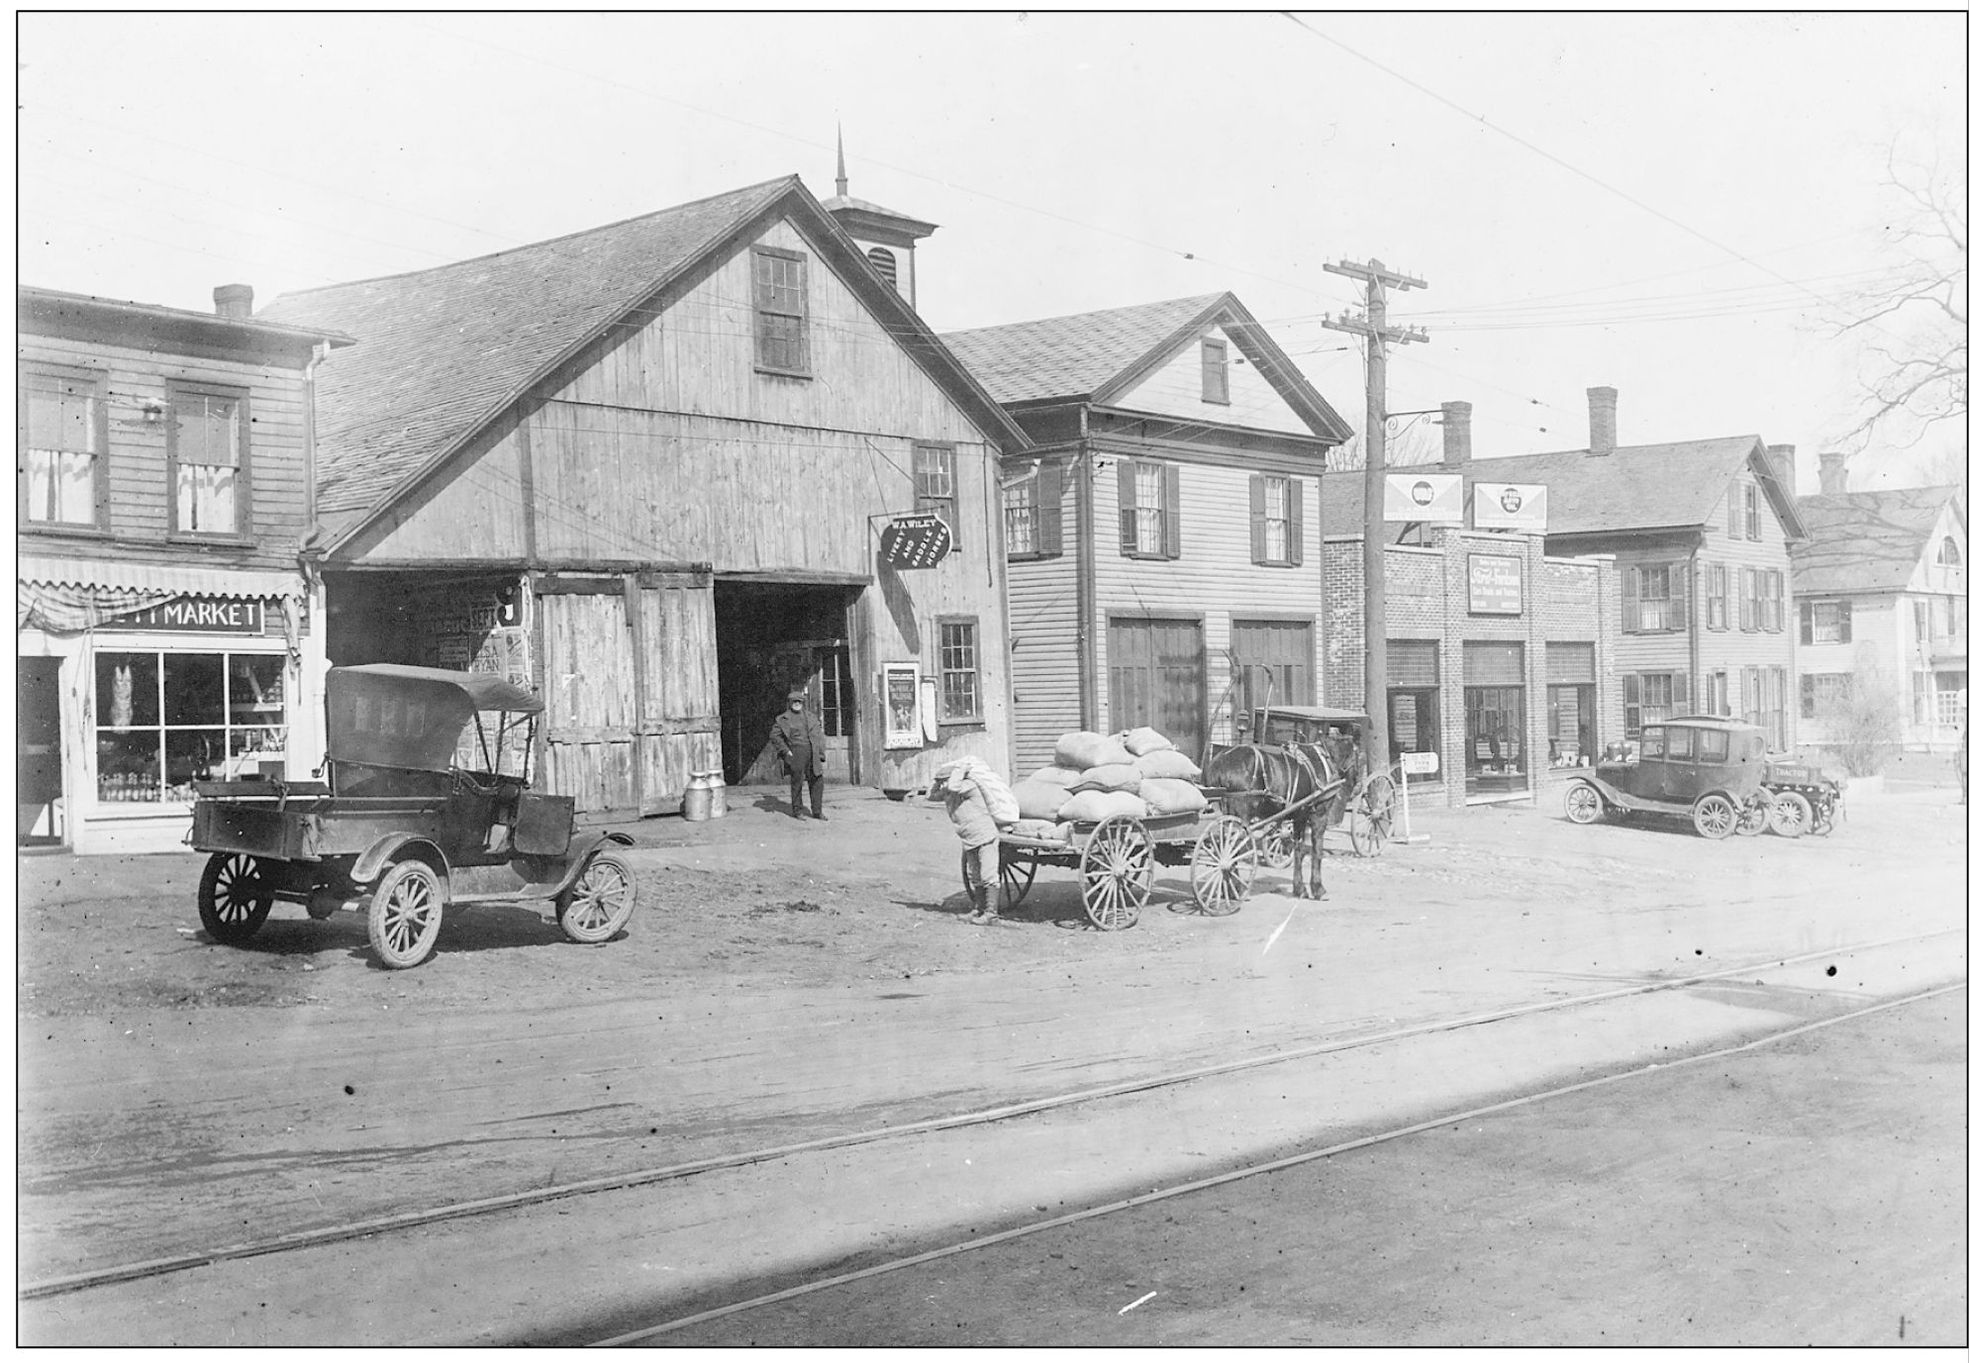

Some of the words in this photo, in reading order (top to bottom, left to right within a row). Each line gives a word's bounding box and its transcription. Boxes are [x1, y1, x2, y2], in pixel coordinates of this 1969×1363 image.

[887, 530, 905, 563] LIVERY
[903, 540, 914, 558] AND
[912, 529, 933, 567] SADDLE
[926, 527, 948, 566] HORSES
[164, 602, 256, 625] MARKET
